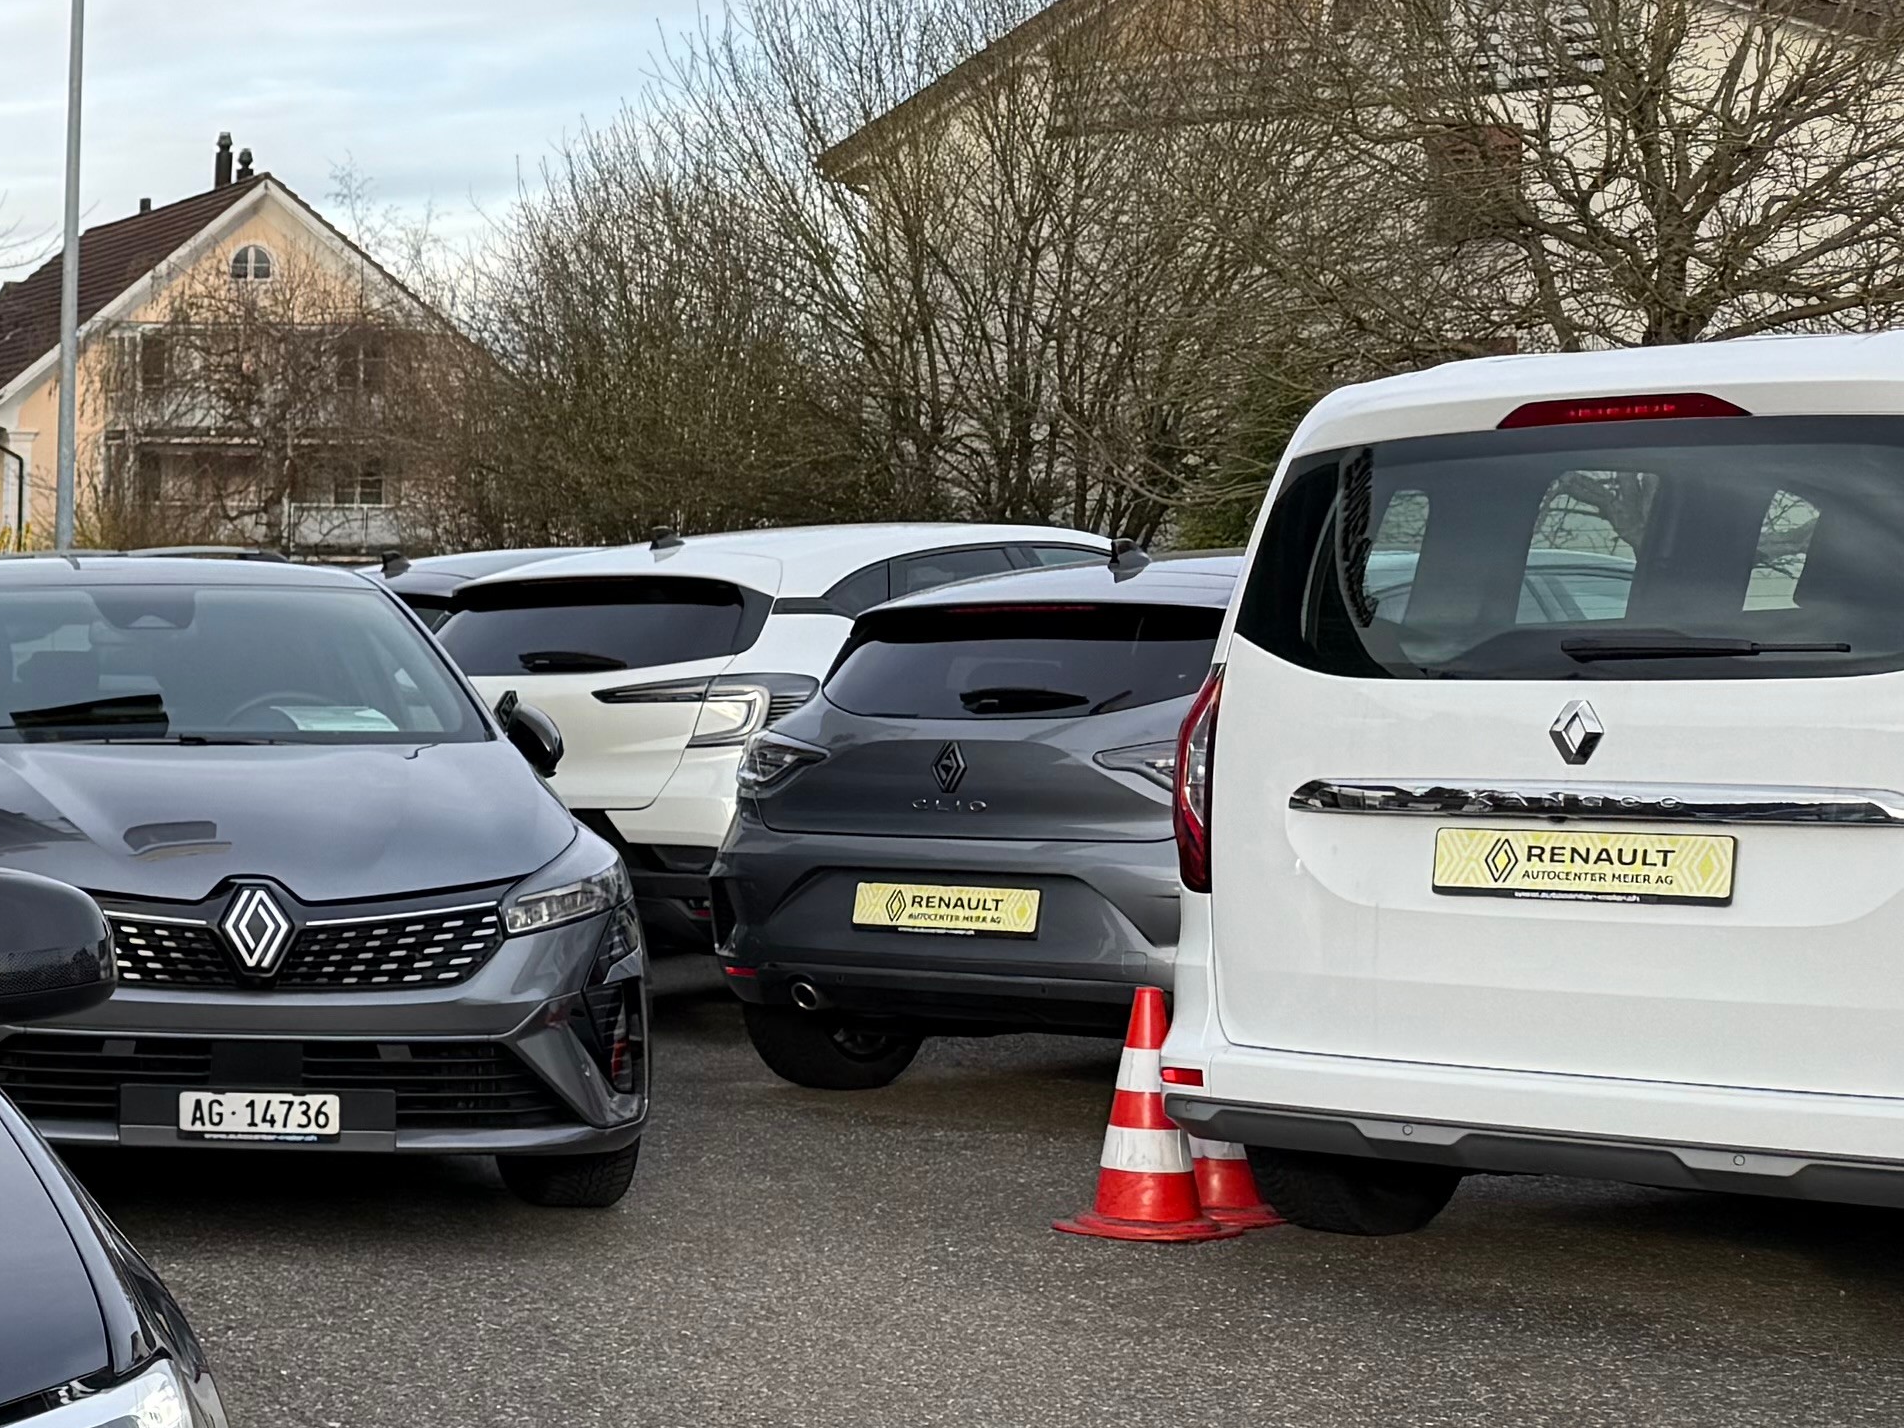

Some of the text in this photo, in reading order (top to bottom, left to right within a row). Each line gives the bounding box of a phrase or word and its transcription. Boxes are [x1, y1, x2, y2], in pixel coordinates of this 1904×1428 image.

[911, 798, 988, 812] CLIO
[1526, 844, 1676, 868] RENAULT
[1521, 869, 1674, 885] AUTOCENTER MEIER AG
[910, 894, 1004, 912] RENAULT
